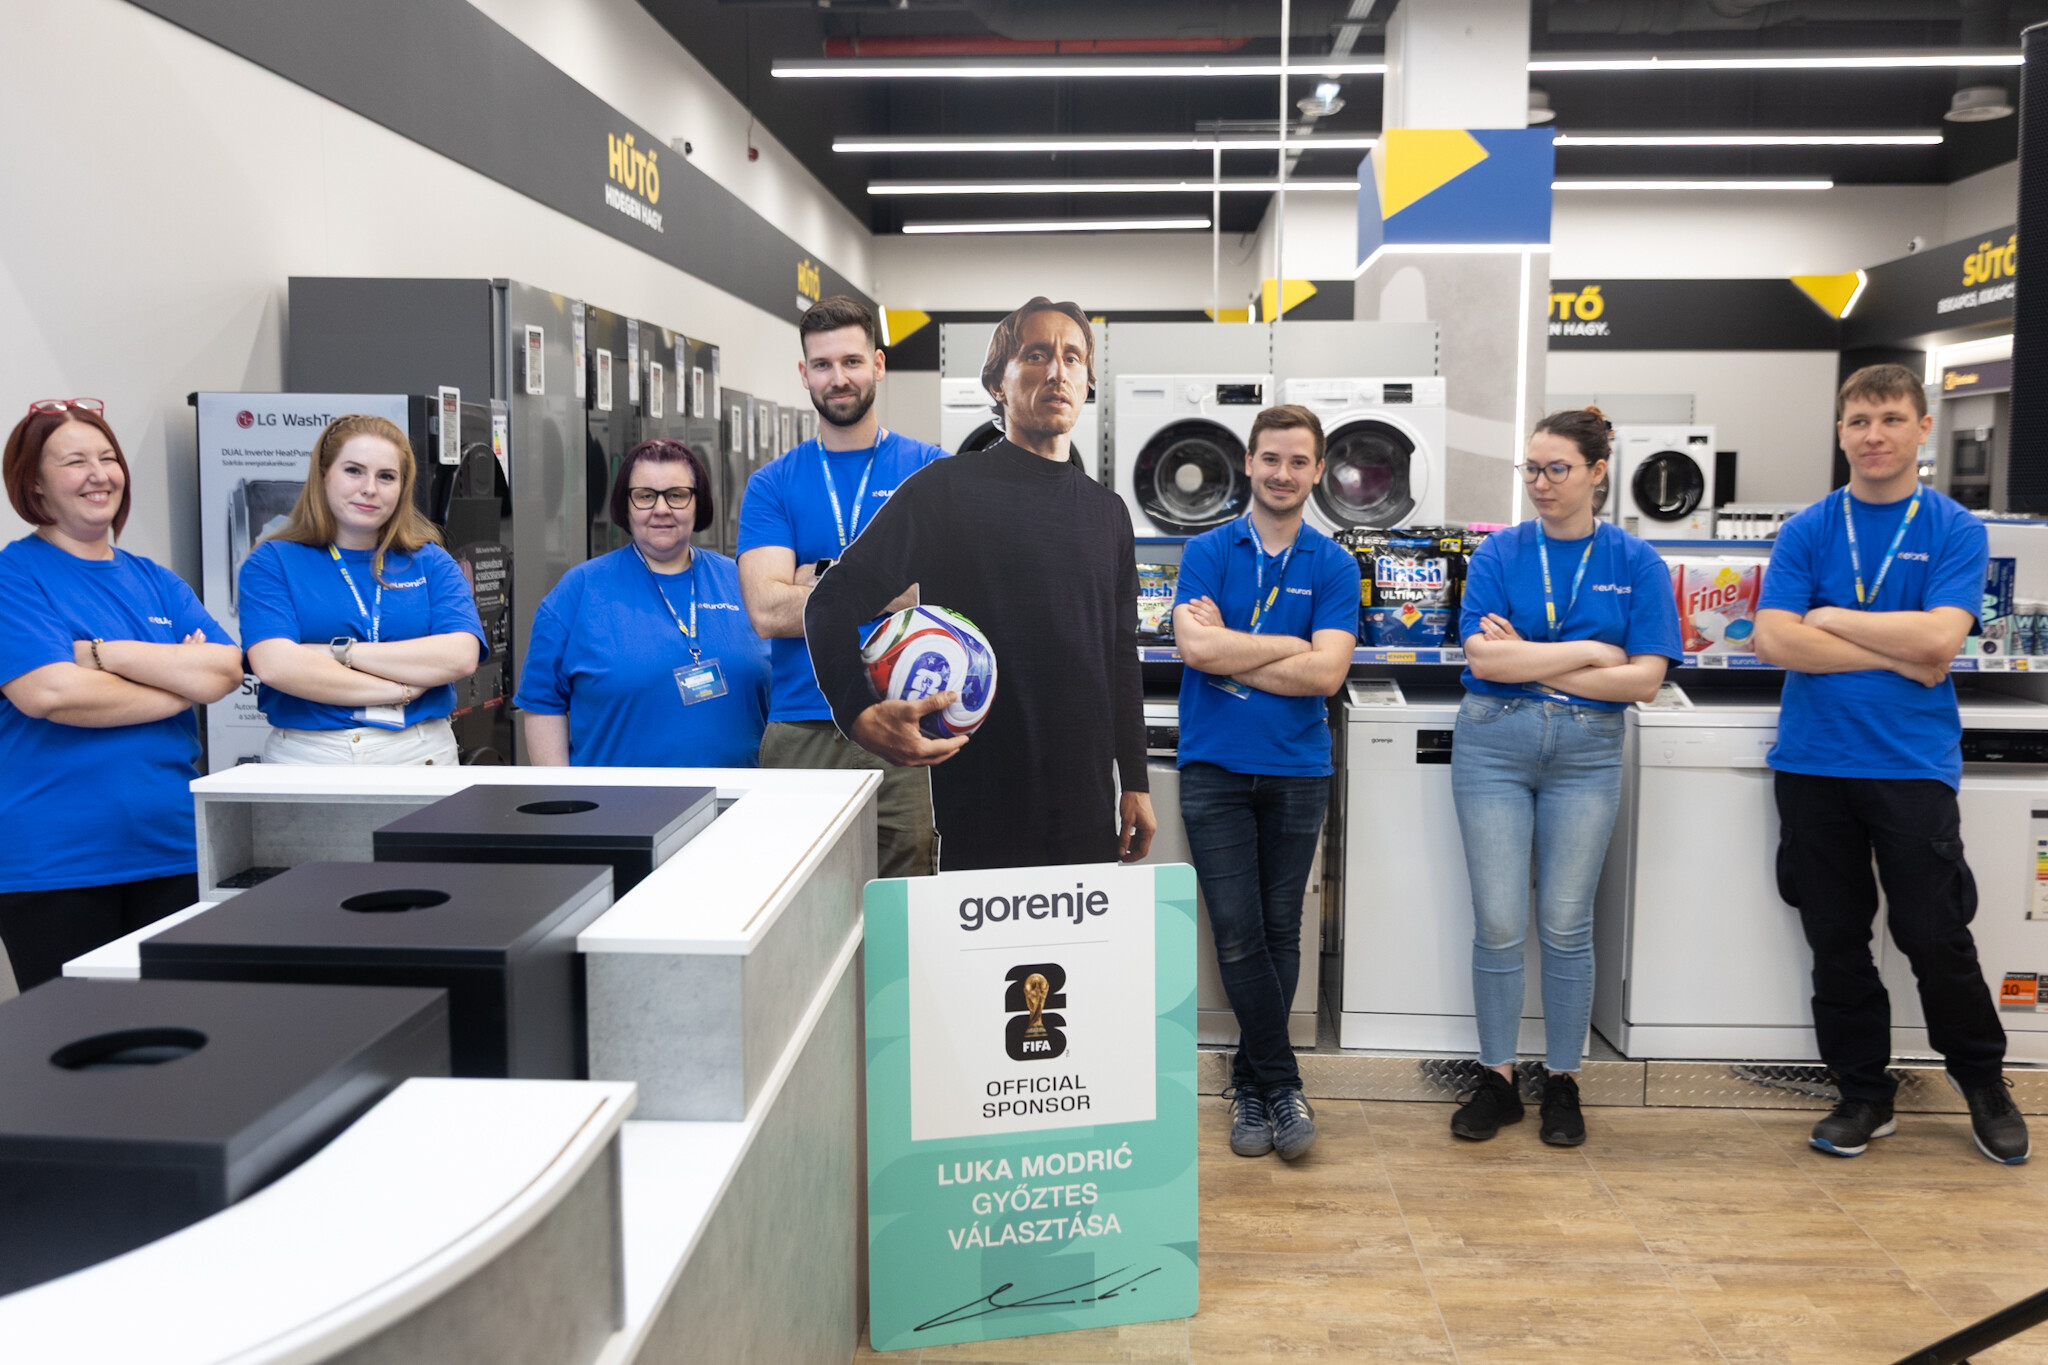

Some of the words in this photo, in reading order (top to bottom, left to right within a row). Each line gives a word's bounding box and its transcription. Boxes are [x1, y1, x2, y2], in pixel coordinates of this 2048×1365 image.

[605, 183, 641, 221] HIDEGEN
[1548, 322, 1562, 337] N
[1563, 321, 1611, 337] HAGY.
[257, 413, 277, 426] LG
[221, 448, 243, 457] DUAL
[244, 449, 274, 457] Inverter
[1377, 557, 1442, 582] finish
[1141, 582, 1173, 597] nish
[1290, 587, 1313, 596] euroni
[1689, 584, 1736, 615] Fine
[702, 602, 740, 612] euronics
[959, 883, 1109, 931] gorenje
[2003, 984, 2020, 996] 10
[1022, 1040, 1052, 1053] FIFA
[986, 1074, 1087, 1097] OFFICIAL
[983, 1095, 1091, 1118] SPONSOR
[938, 1158, 1013, 1186] LUKA
[1021, 1142, 1133, 1178] MODRIĆ
[972, 1183, 1098, 1215] GYŐZTES
[947, 1211, 1122, 1251] VÁLASZTÁSA
